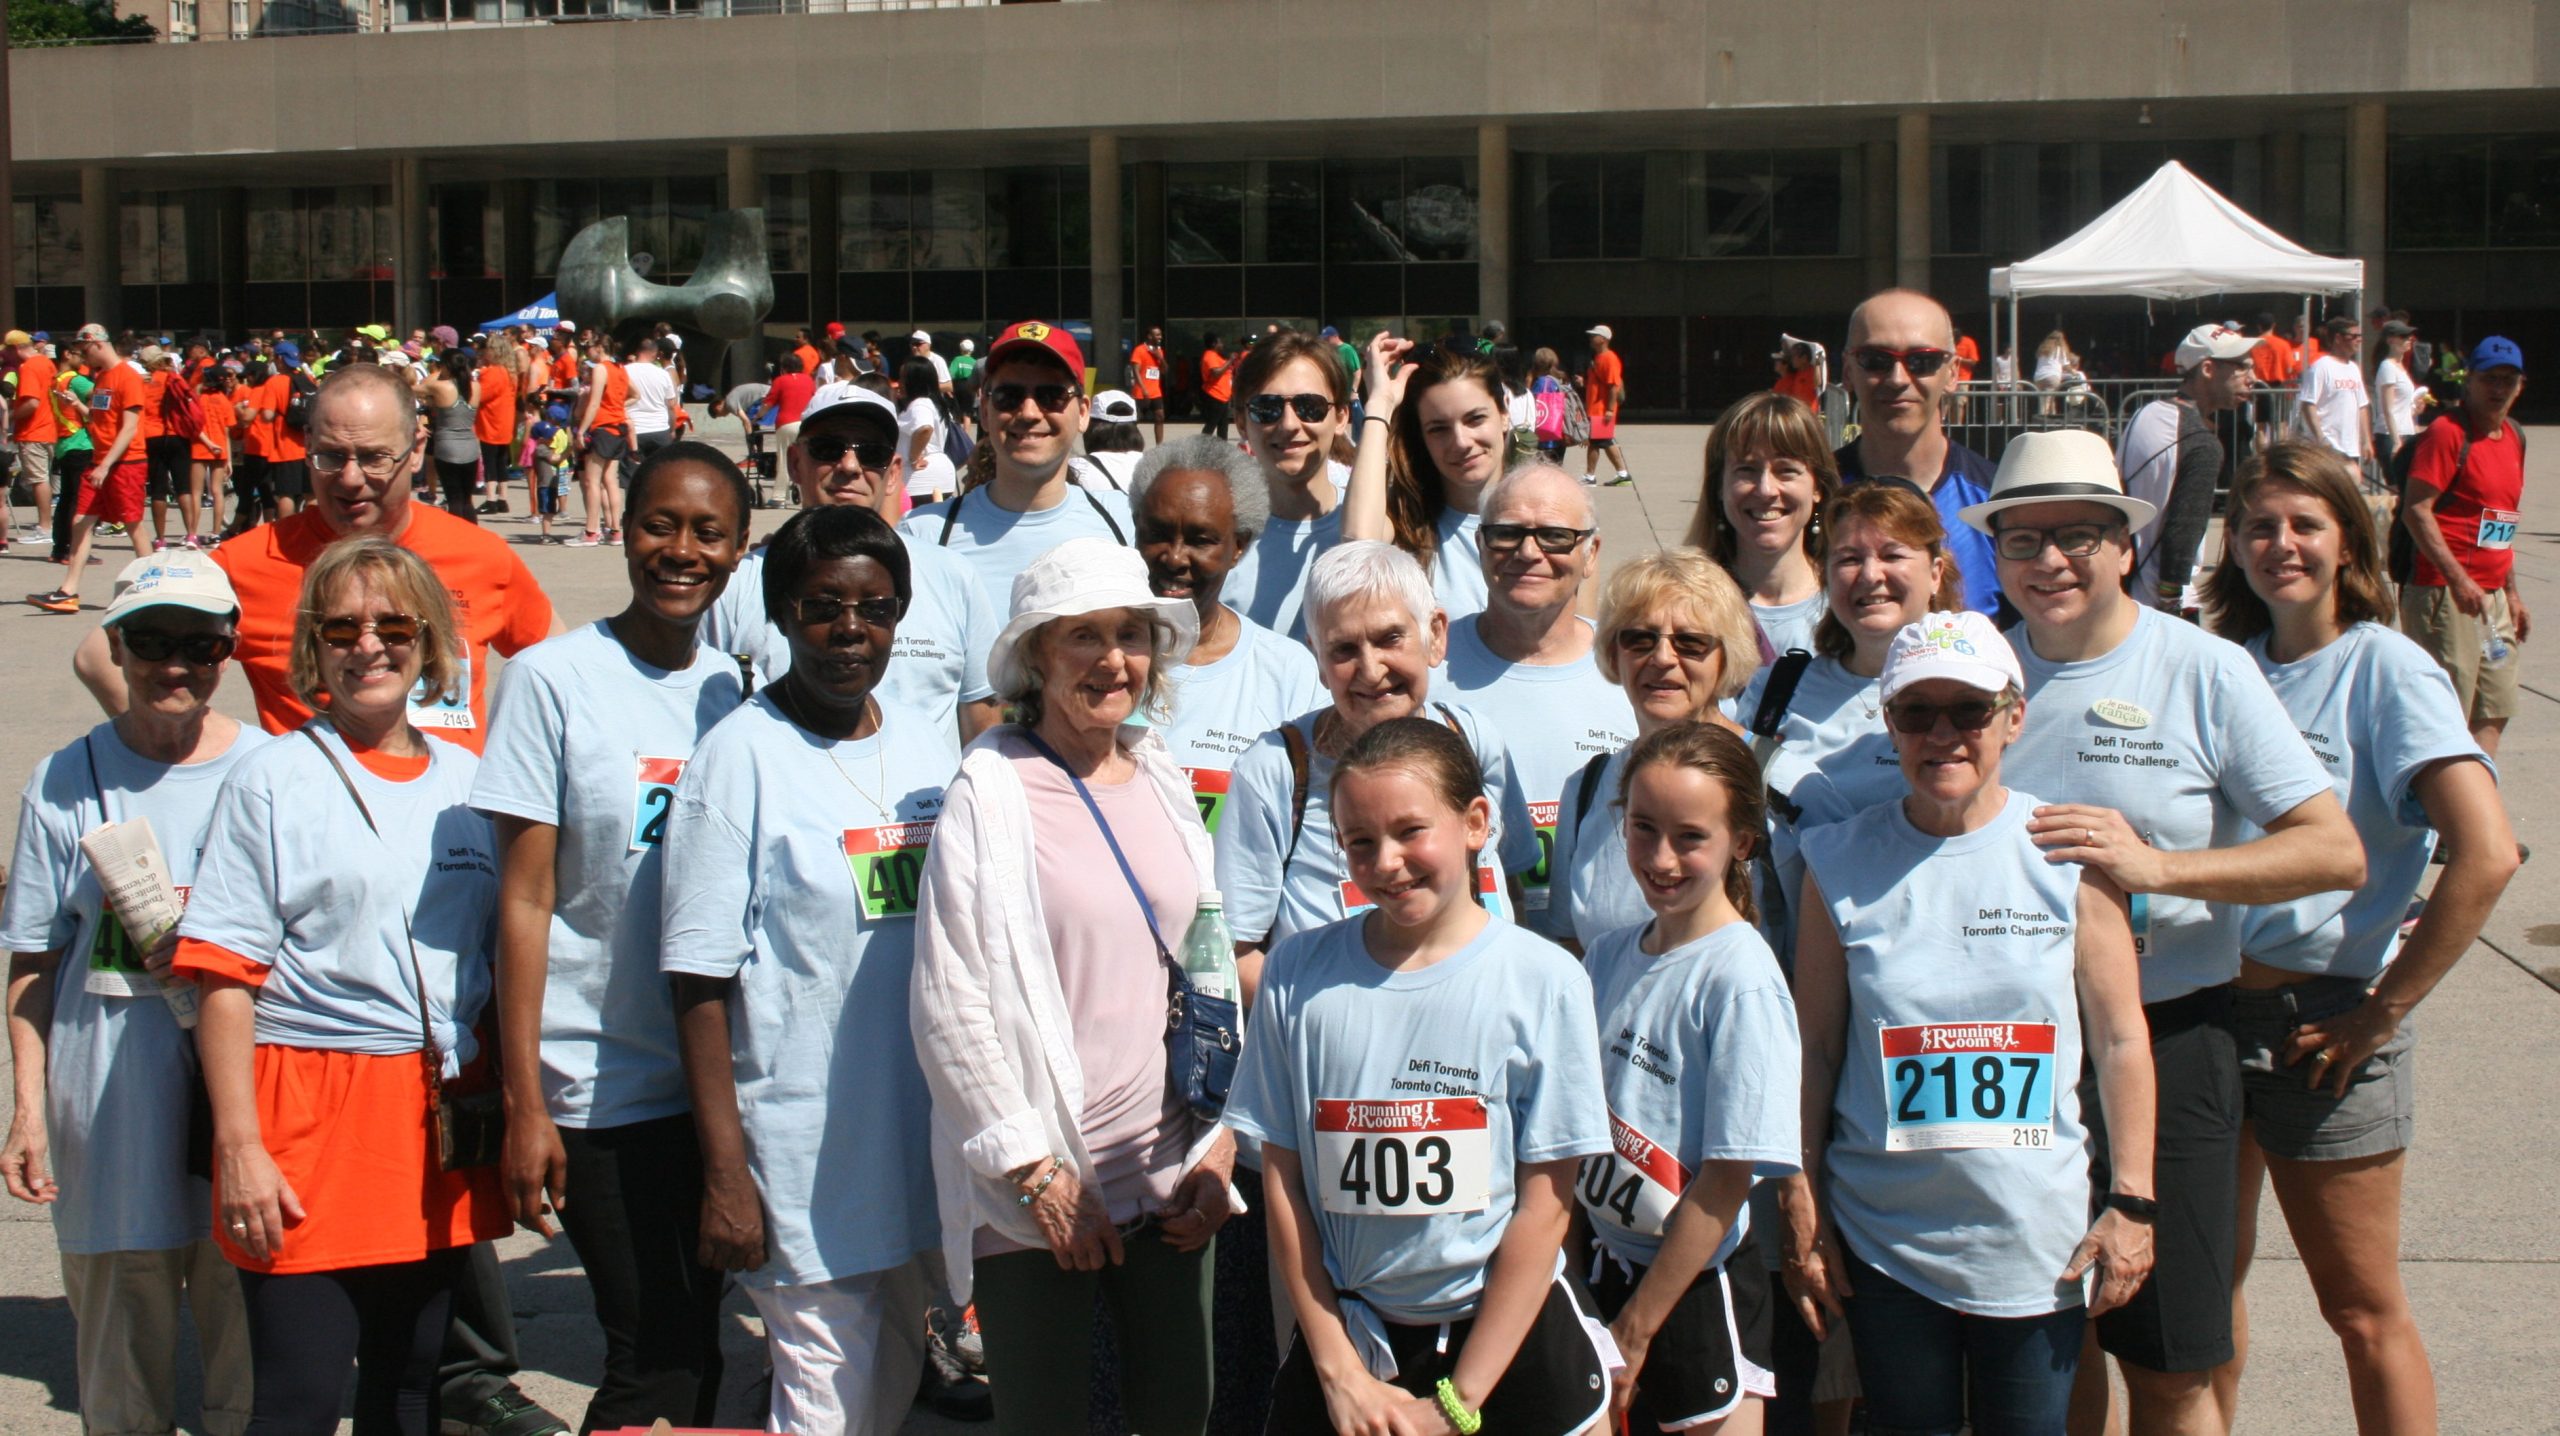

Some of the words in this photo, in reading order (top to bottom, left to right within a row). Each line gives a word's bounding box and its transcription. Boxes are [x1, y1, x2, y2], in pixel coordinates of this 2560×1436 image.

[904, 637, 935, 646] Toronto
[2096, 702, 2148, 725] français
[2118, 703, 2139, 713] parle
[442, 712, 470, 727] 2149
[1205, 728, 1225, 740] Défi
[1588, 729, 1606, 740] Défi
[1190, 740, 1226, 753] Toronto
[1574, 741, 1610, 754] Toronto
[2094, 735, 2117, 747] Défi
[2120, 737, 2164, 750] Toronto
[2077, 751, 2120, 764] Toronto
[2124, 754, 2180, 769] Challenge
[436, 861, 477, 872] Toronto
[1978, 908, 2002, 920] Défi
[2005, 908, 2049, 921] Toronto
[1962, 925, 2007, 937] Toronto
[2010, 924, 2067, 936] Challenge
[1933, 1025, 2003, 1044] Running
[1636, 1036, 1669, 1062] Toronto
[1408, 1059, 1431, 1073] Défi
[1434, 1061, 1479, 1081] Toronto
[1631, 1054, 1677, 1085] Challenge
[1390, 1078, 1432, 1092] Toronto
[1895, 1056, 2040, 1122] 2187
[1358, 1102, 1423, 1121] Running
[2013, 1128, 2048, 1146] 2187
[1340, 1135, 1454, 1207] 403
